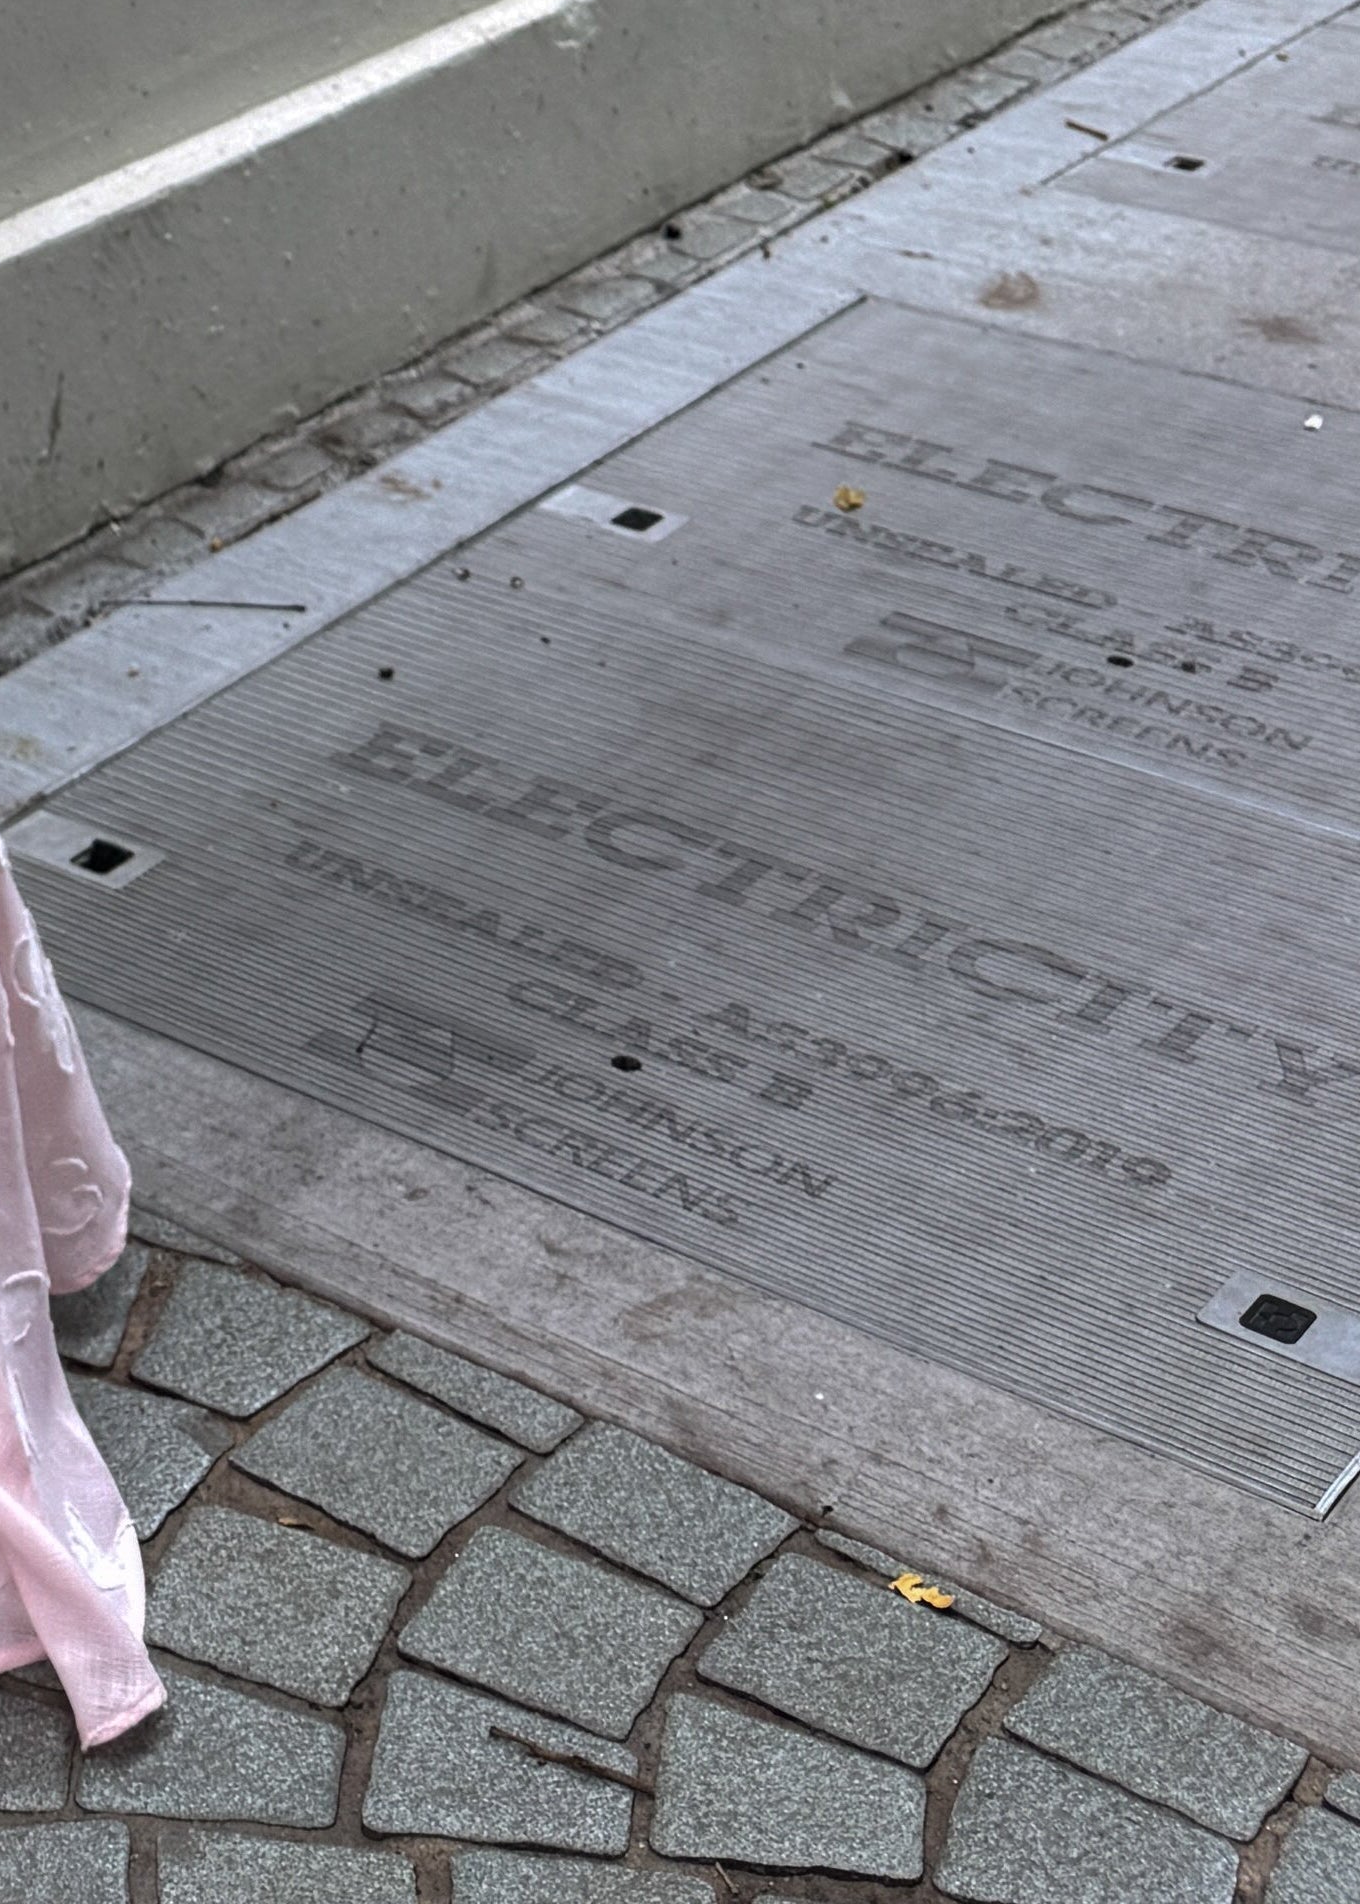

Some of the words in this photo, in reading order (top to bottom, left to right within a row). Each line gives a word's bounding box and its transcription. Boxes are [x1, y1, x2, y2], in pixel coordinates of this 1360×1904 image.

[792, 504, 1118, 610] UNSEALED
[1004, 685, 1246, 767] SCREENS
[1046, 662, 1313, 751] JOHNSON
[284, 839, 645, 990] UNSEALED
[328, 722, 1360, 1105] ELECTRICITY
[510, 979, 748, 1085] CLASS
[750, 1070, 814, 1111] B
[470, 1099, 740, 1227] SCREENS
[520, 1064, 837, 1199] JOHNSON
